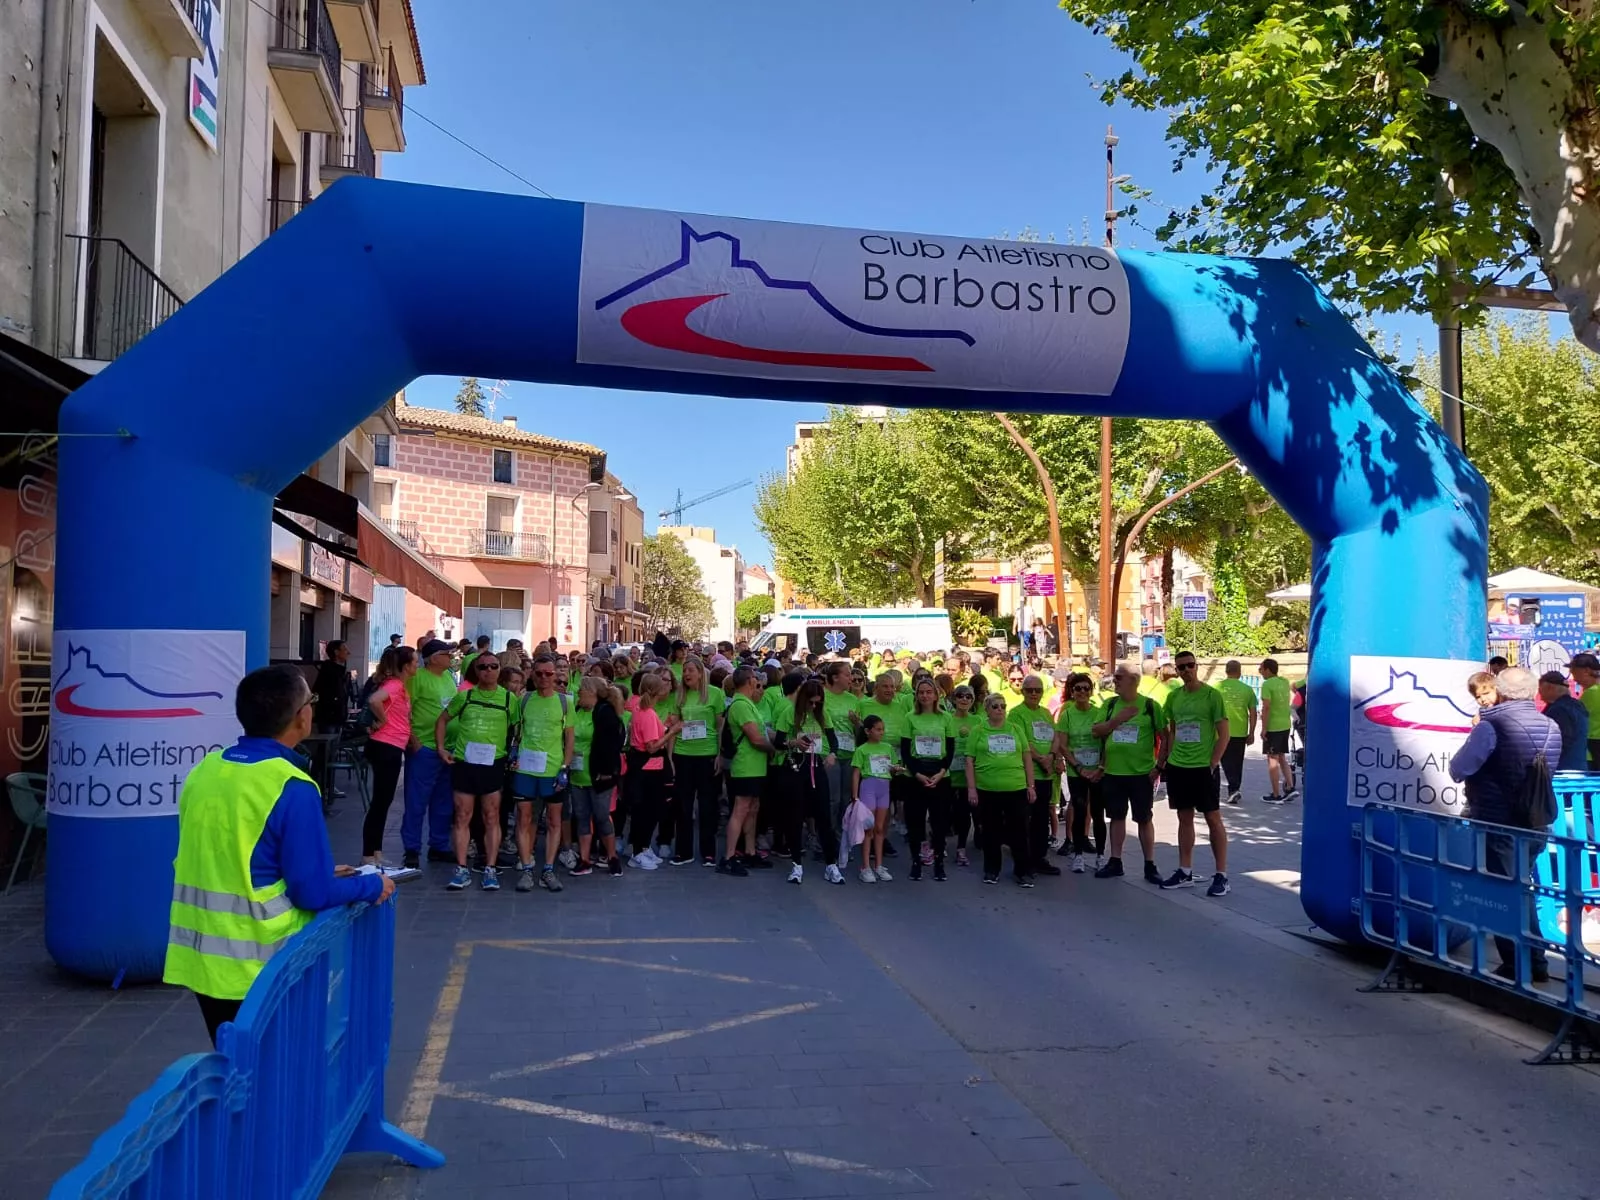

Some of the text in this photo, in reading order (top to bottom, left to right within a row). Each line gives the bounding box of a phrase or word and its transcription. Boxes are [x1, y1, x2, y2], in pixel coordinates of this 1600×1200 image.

[859, 235, 1110, 271] Club Atletismo
[863, 262, 1116, 316] Barbastro
[50, 739, 86, 767] Club
[1355, 746, 1415, 771] Club
[49, 774, 182, 807] Barbast
